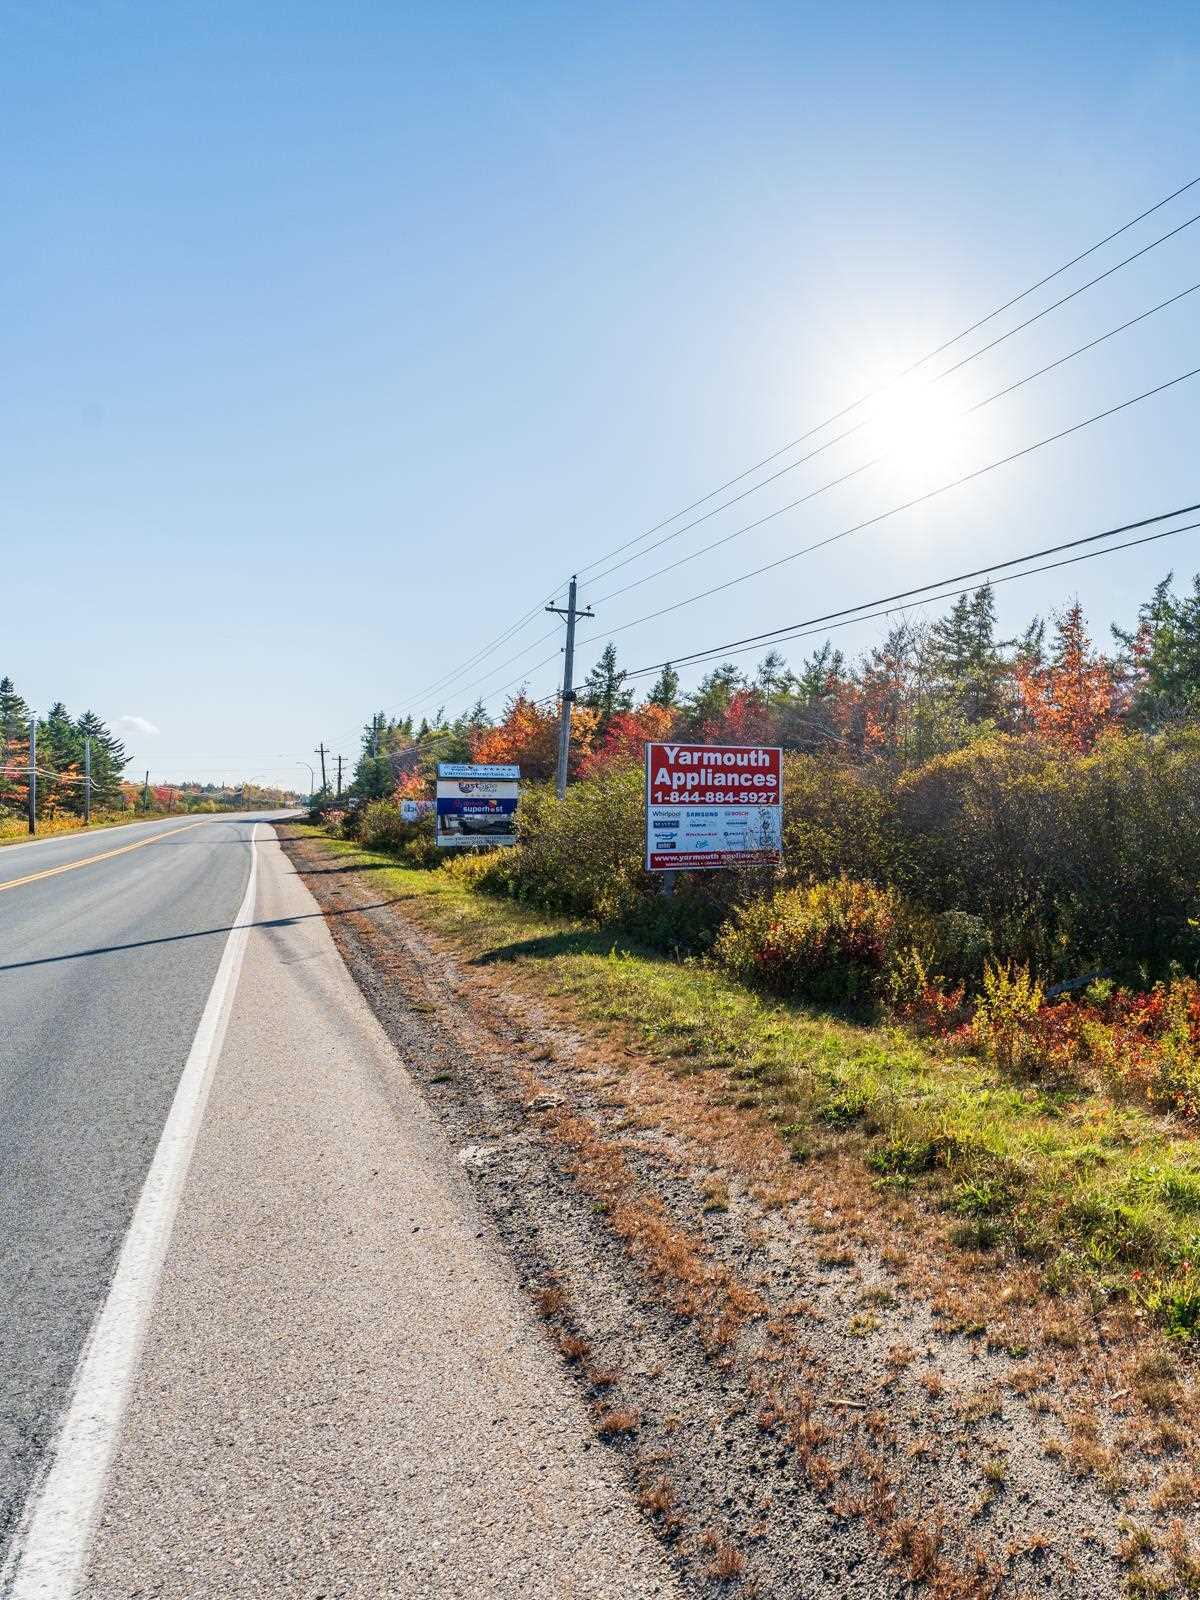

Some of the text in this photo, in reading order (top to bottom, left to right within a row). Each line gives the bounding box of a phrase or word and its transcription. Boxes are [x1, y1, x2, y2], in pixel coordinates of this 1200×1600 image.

[664, 746, 770, 766] Yarmouth
[655, 768, 777, 790] Appliances
[655, 791, 776, 803] 1-844-884-5927
[652, 810, 681, 818] Whirlpool
